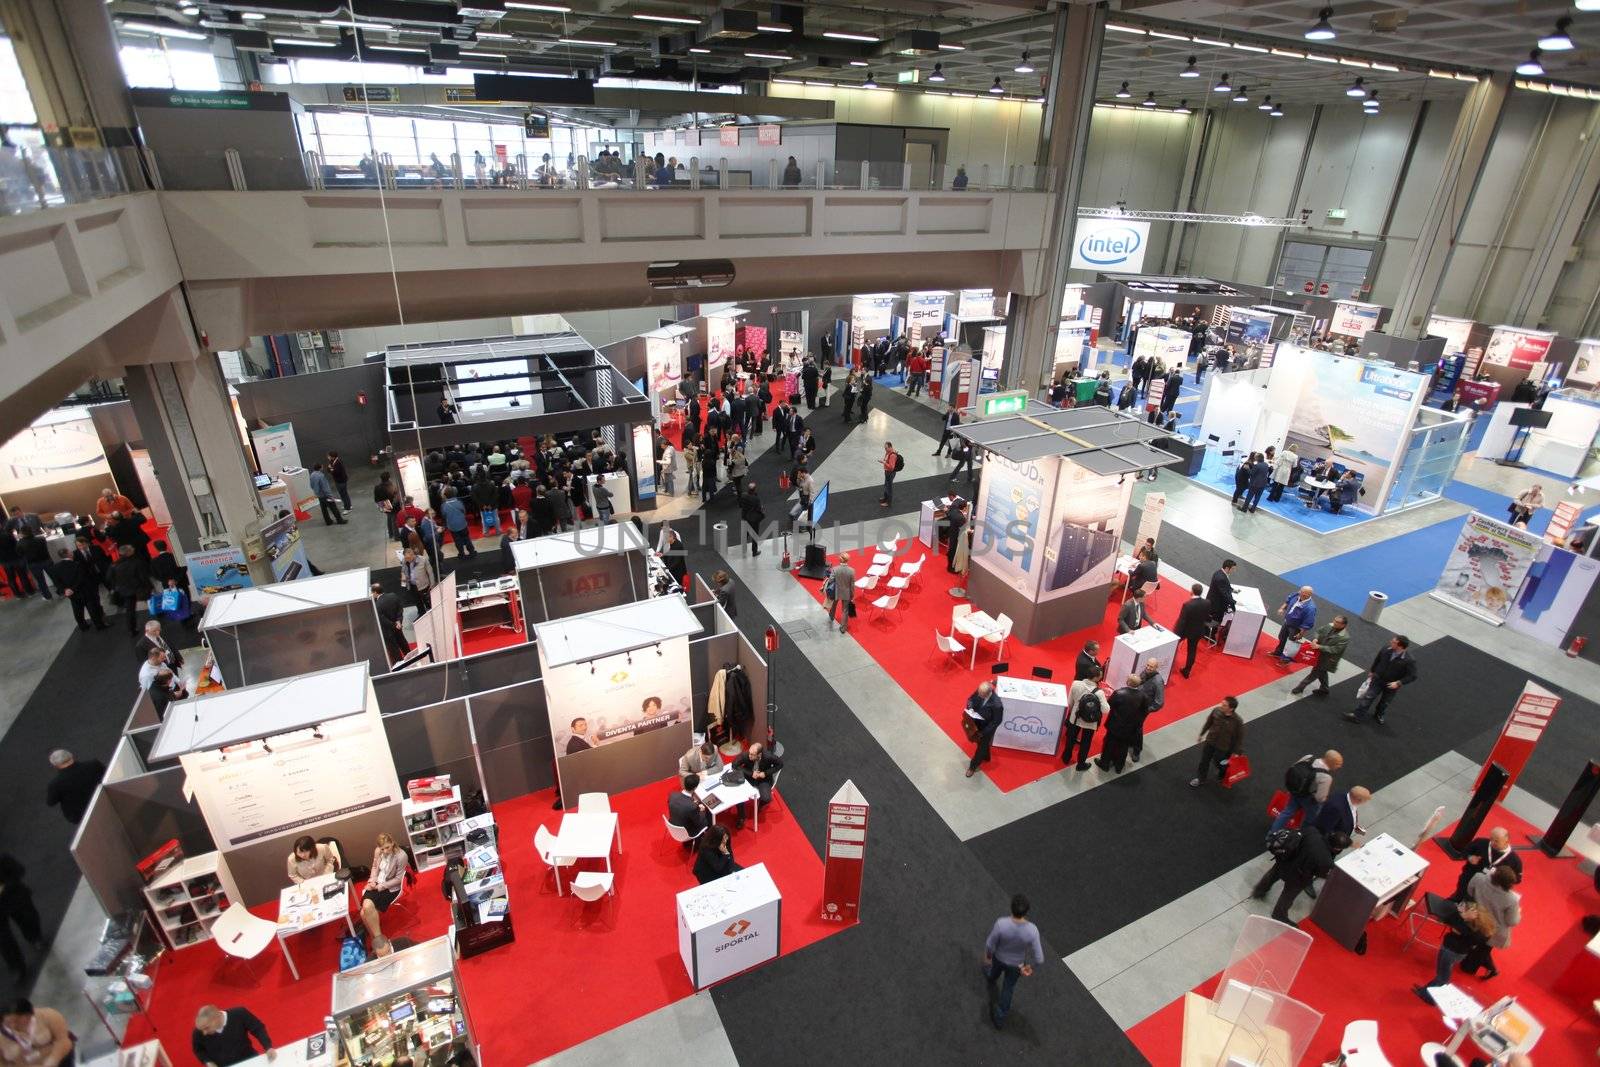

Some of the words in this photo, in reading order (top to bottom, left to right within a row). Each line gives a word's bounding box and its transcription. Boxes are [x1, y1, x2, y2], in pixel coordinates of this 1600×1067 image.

[1087, 234, 1130, 254] intel
[912, 309, 940, 319] SHC
[605, 724, 637, 738] DIVENTA
[637, 714, 671, 729] PARTNER
[1003, 720, 1048, 736] CLOUD
[714, 930, 760, 954] SIPORTAL
